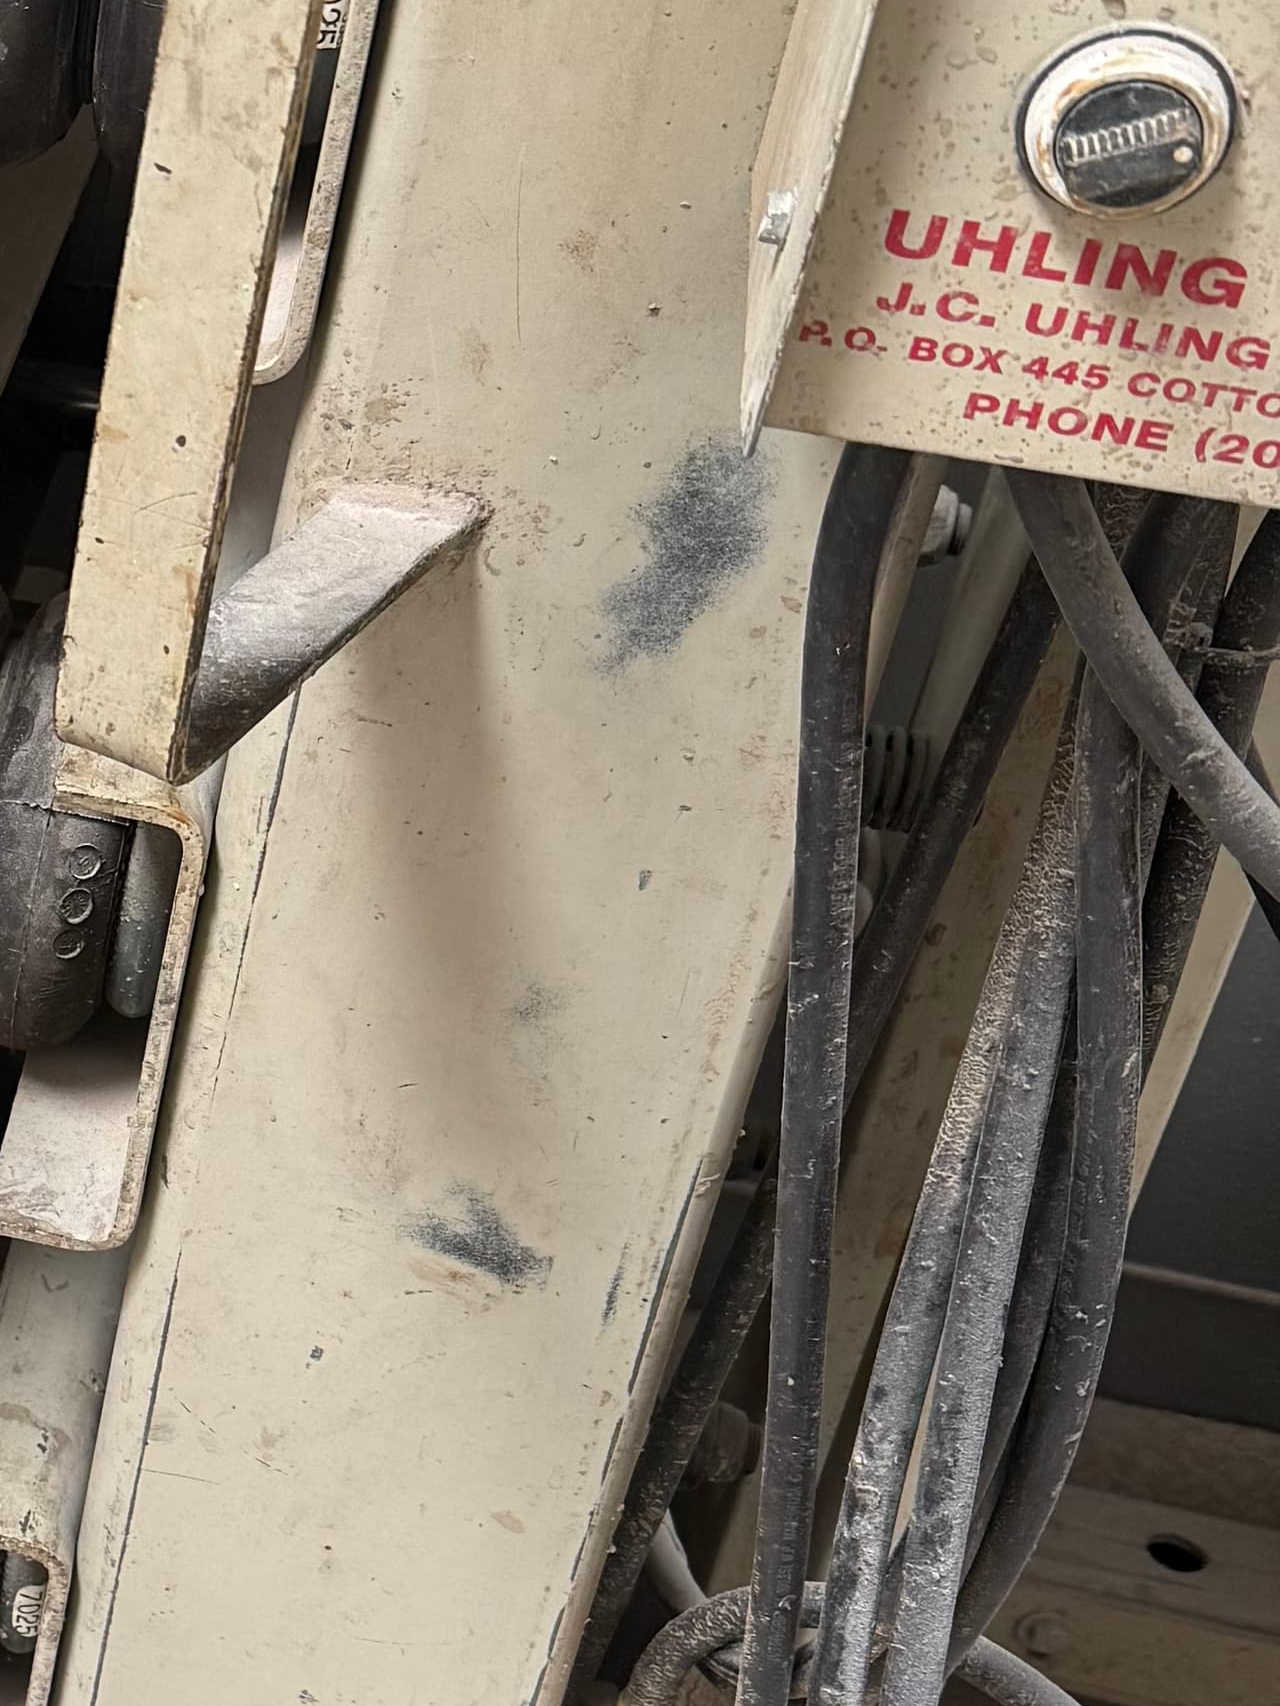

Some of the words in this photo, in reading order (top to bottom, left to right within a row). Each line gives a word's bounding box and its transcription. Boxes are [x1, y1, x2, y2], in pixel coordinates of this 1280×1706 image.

[883, 208, 1248, 309] UHLING
[875, 282, 996, 327] J.C.
[1025, 302, 1270, 370] UHLING
[907, 336, 1007, 374] BOX
[1021, 356, 1111, 390] 445
[1127, 372, 1280, 427] COTTO
[963, 392, 1175, 452] PHONE
[15, 1591, 44, 1636] 7025
